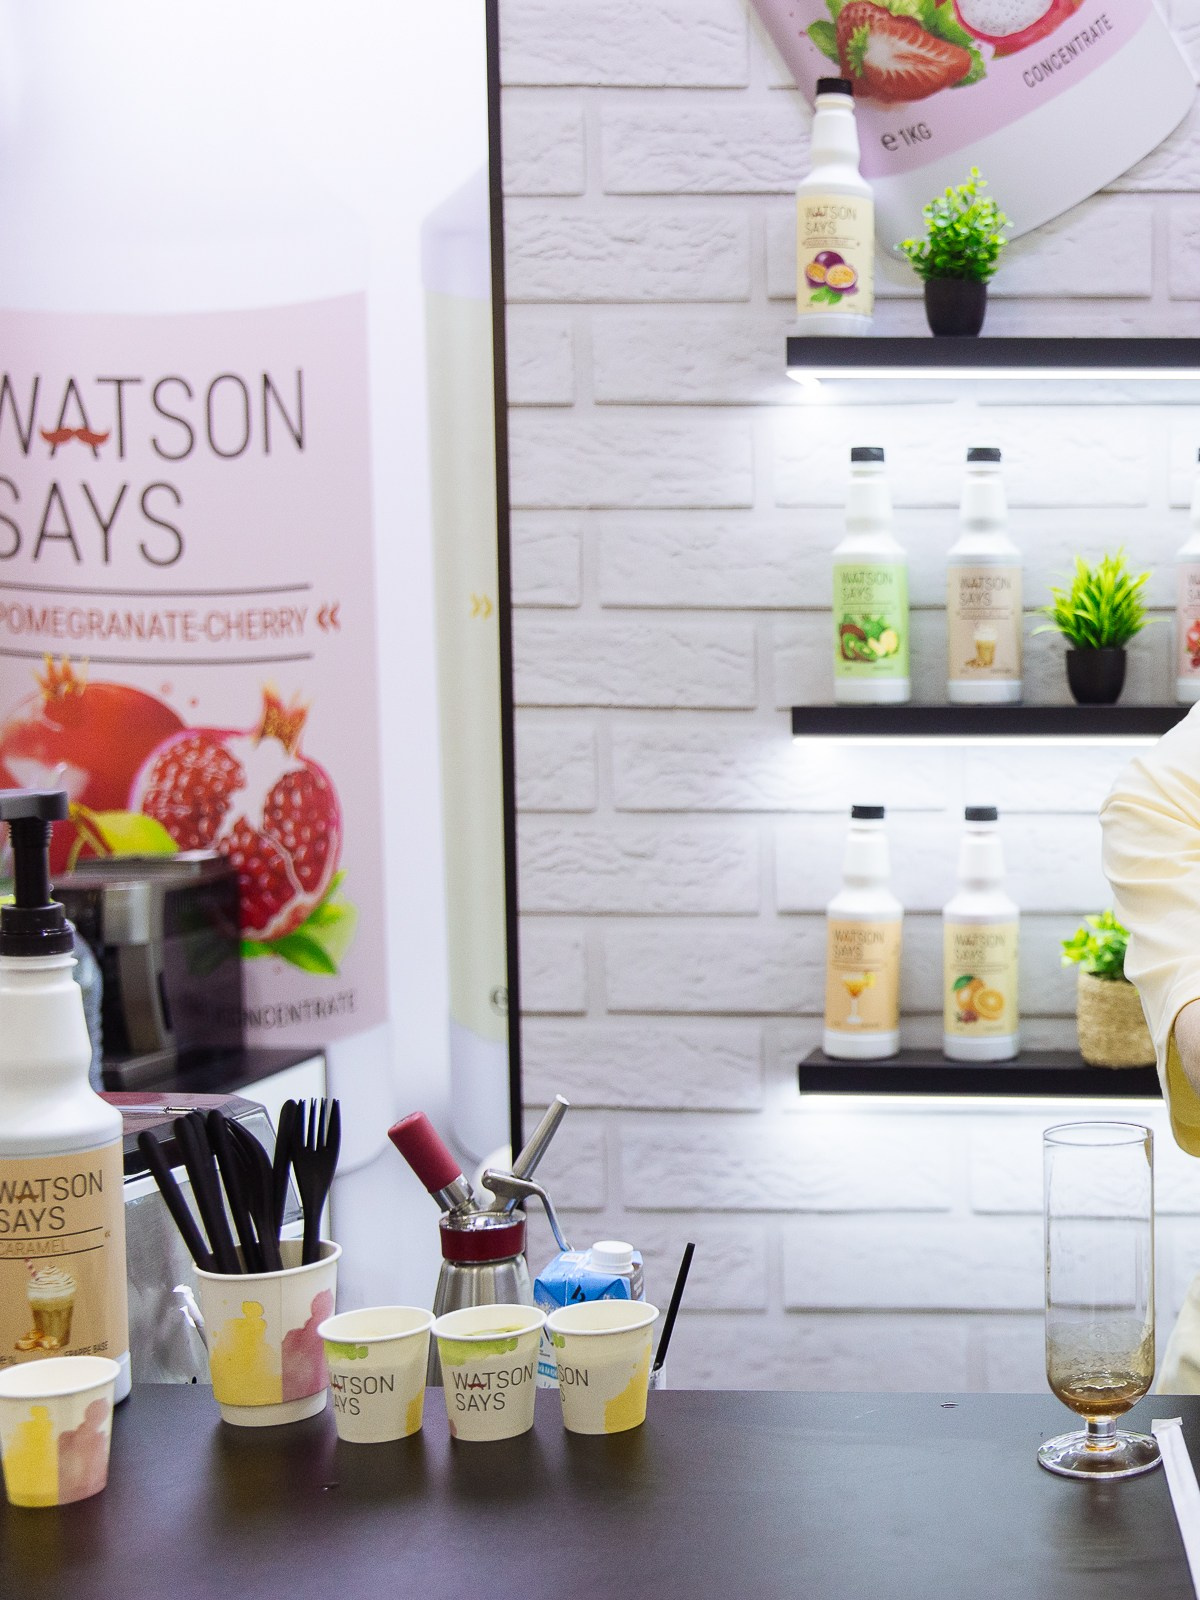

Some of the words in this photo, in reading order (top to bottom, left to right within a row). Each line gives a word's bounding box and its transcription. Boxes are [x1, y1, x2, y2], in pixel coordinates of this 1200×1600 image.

[1022, 13, 1114, 88] CONCENTRATE
[899, 121, 932, 147] 1KG
[805, 206, 857, 221] WATSON
[805, 221, 837, 236] SAYS
[0, 474, 185, 568] SAYS
[842, 571, 893, 586] WATSON
[960, 576, 1011, 591] WATSON
[841, 586, 873, 601] SAYS
[960, 591, 992, 606] SAYS
[0, 1206, 66, 1233] SAYS
[92, 1340, 109, 1353] BASE
[331, 1373, 394, 1395] ATSON
[452, 1362, 534, 1391] WATSON
[557, 1363, 589, 1387] SON
[334, 1393, 360, 1416] AYS
[455, 1392, 506, 1412] SAYS
